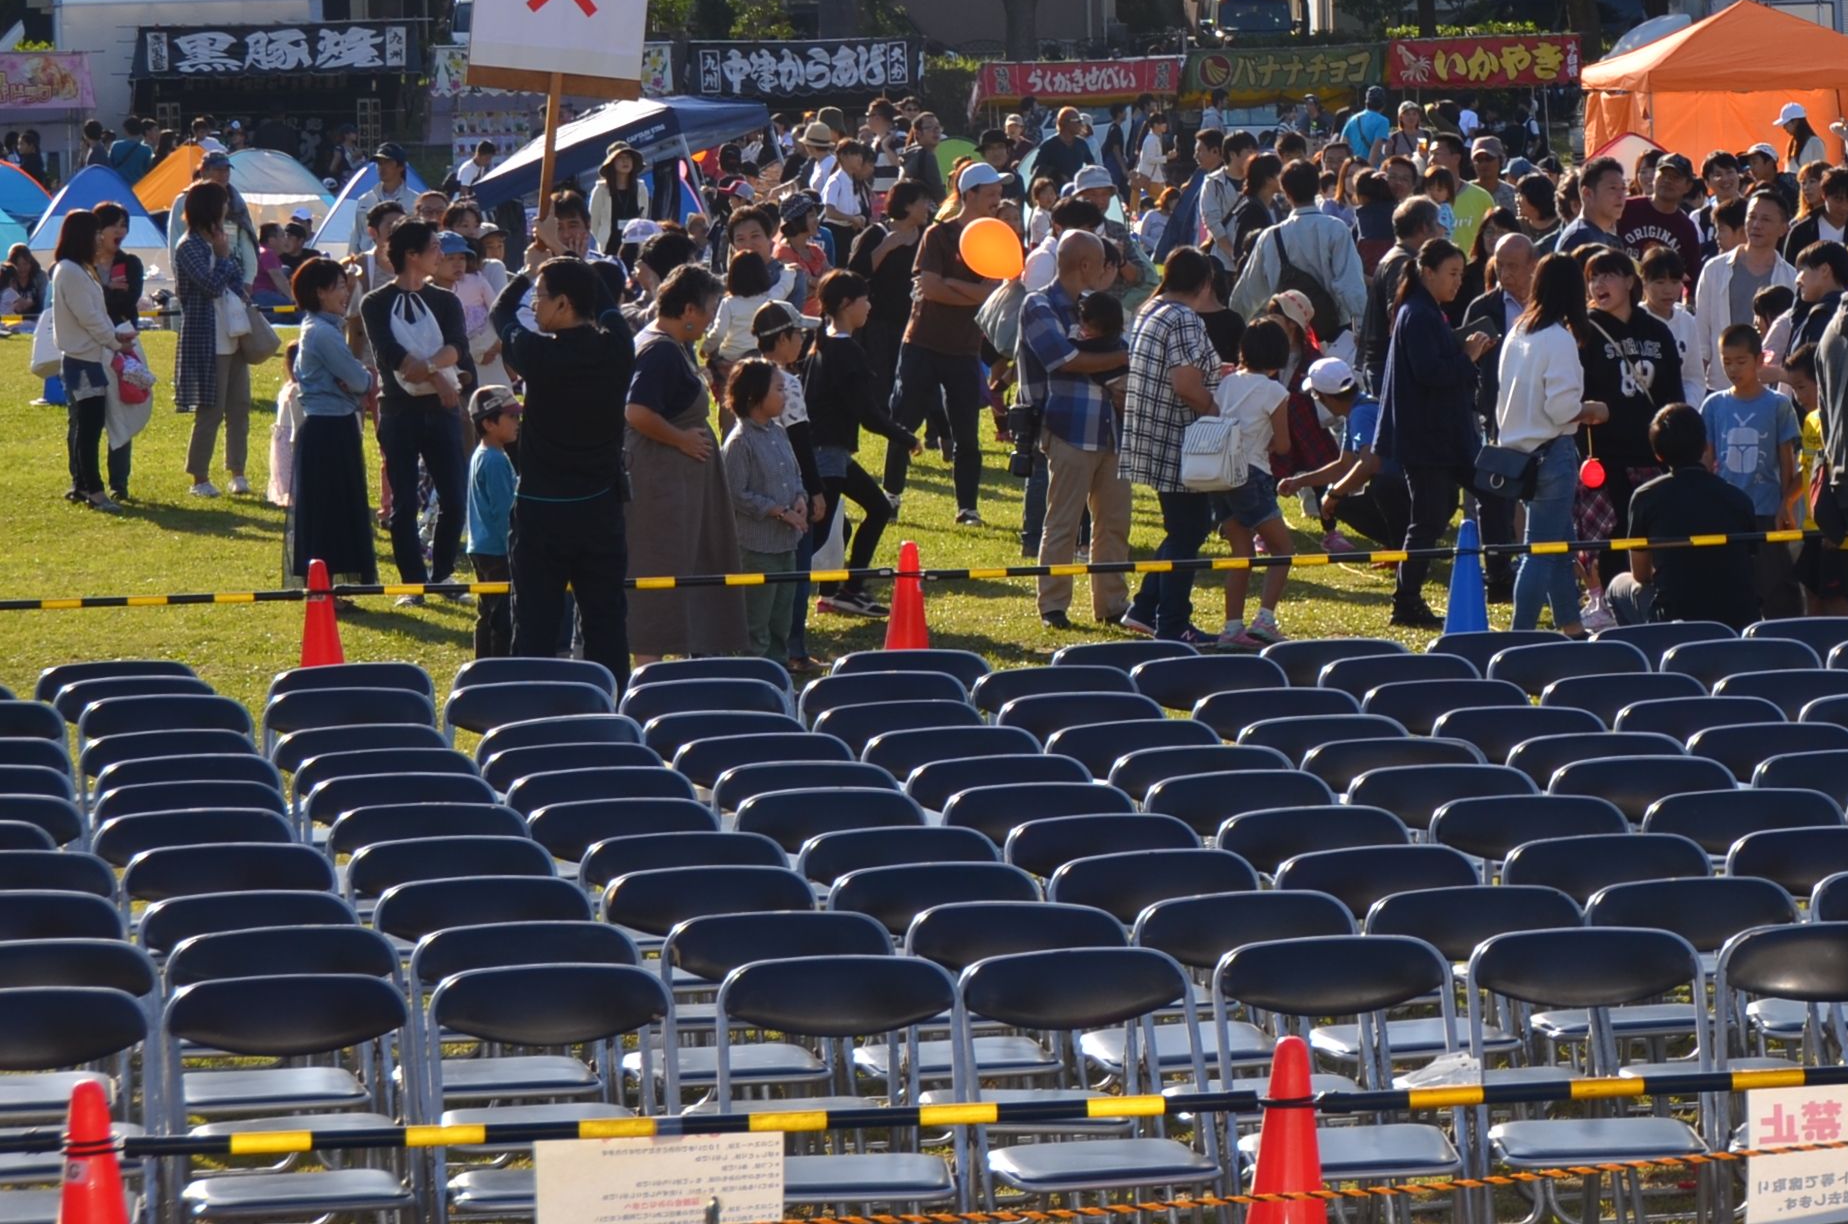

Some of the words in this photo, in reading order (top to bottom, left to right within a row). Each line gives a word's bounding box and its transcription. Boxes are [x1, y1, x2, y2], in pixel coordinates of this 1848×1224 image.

[174, 27, 384, 73] 黒豚焼
[389, 32, 404, 63] 九州
[1434, 42, 1564, 82] いかやき
[703, 56, 719, 90] 九州
[722, 43, 886, 94] 中津からあげ
[1027, 66, 1137, 94] らくがきせんべい
[1230, 51, 1371, 87] バナナチョコ
[1624, 225, 1681, 254] ORIGINAL
